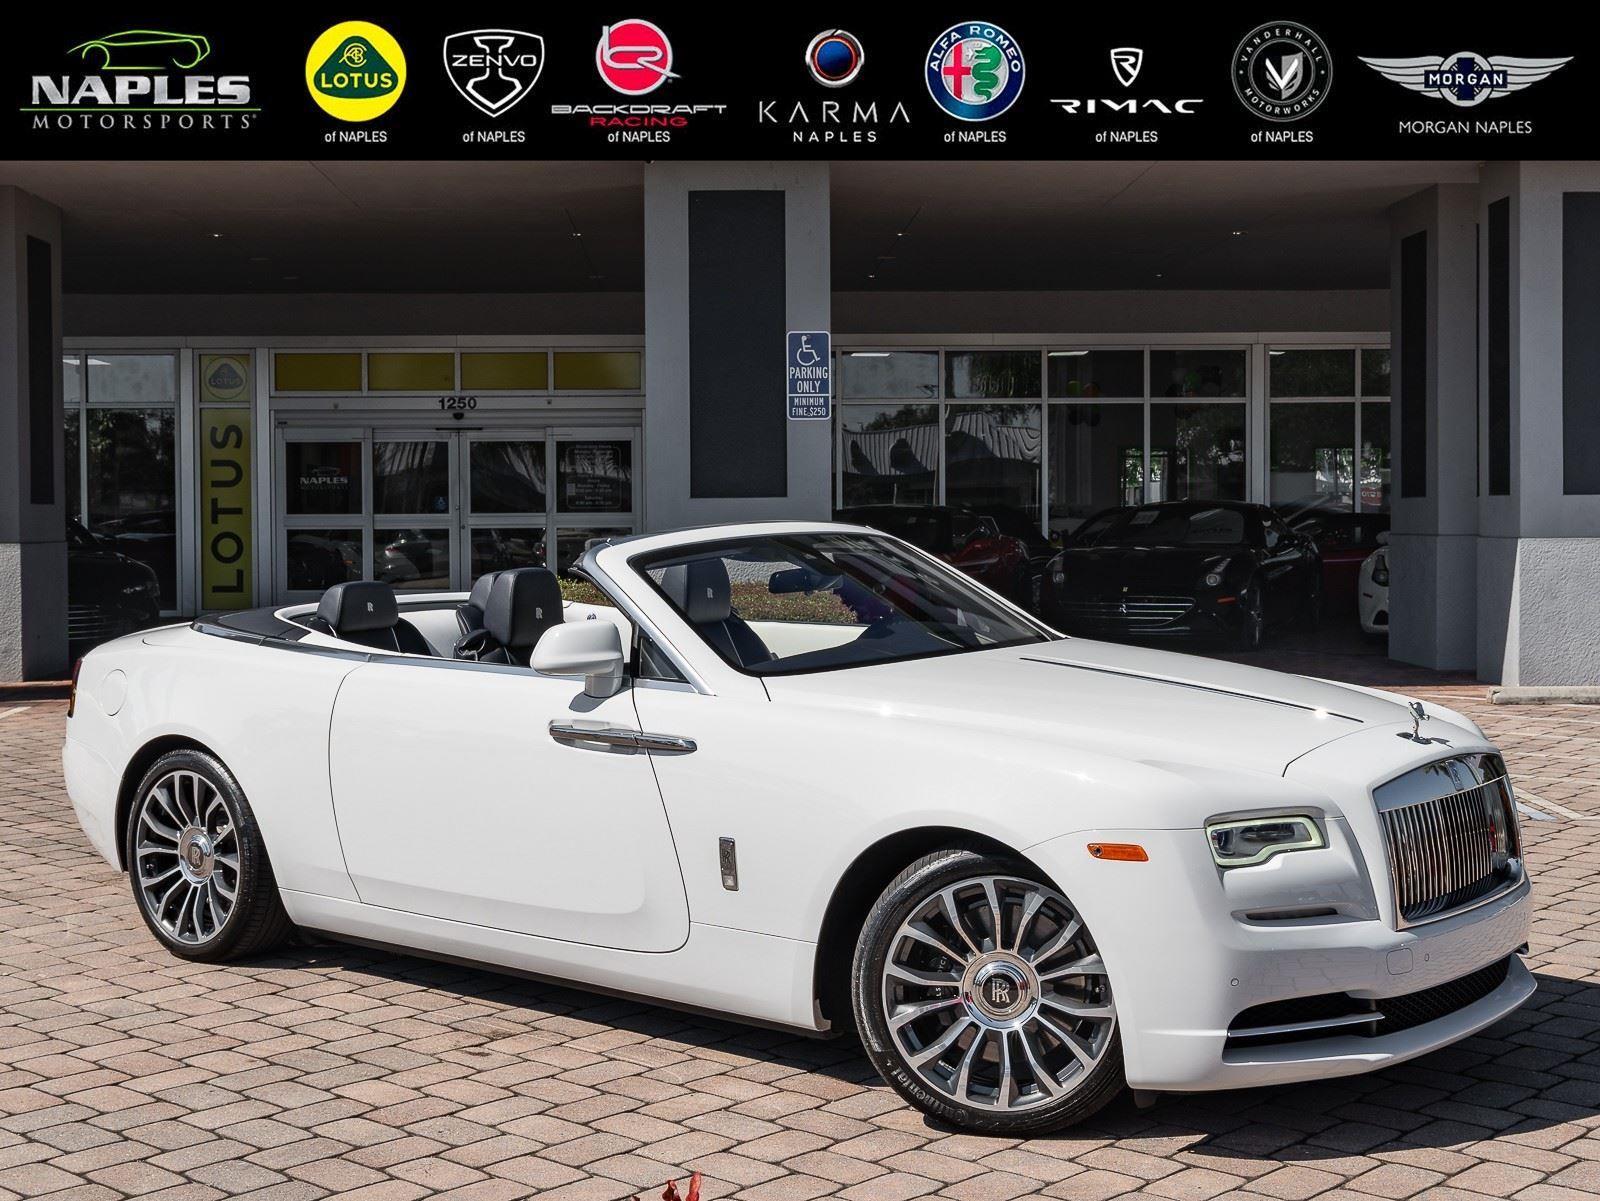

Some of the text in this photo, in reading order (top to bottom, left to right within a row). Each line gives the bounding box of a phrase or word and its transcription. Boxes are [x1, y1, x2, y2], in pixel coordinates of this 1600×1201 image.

[789, 366, 828, 379] PARKING
[797, 380, 821, 393] ONLY
[438, 396, 477, 411] 1250
[794, 397, 824, 406] MINIMUM
[792, 407, 826, 417] FINE $250
[299, 476, 349, 485] NAPLES
[210, 424, 244, 593] LOTUS
